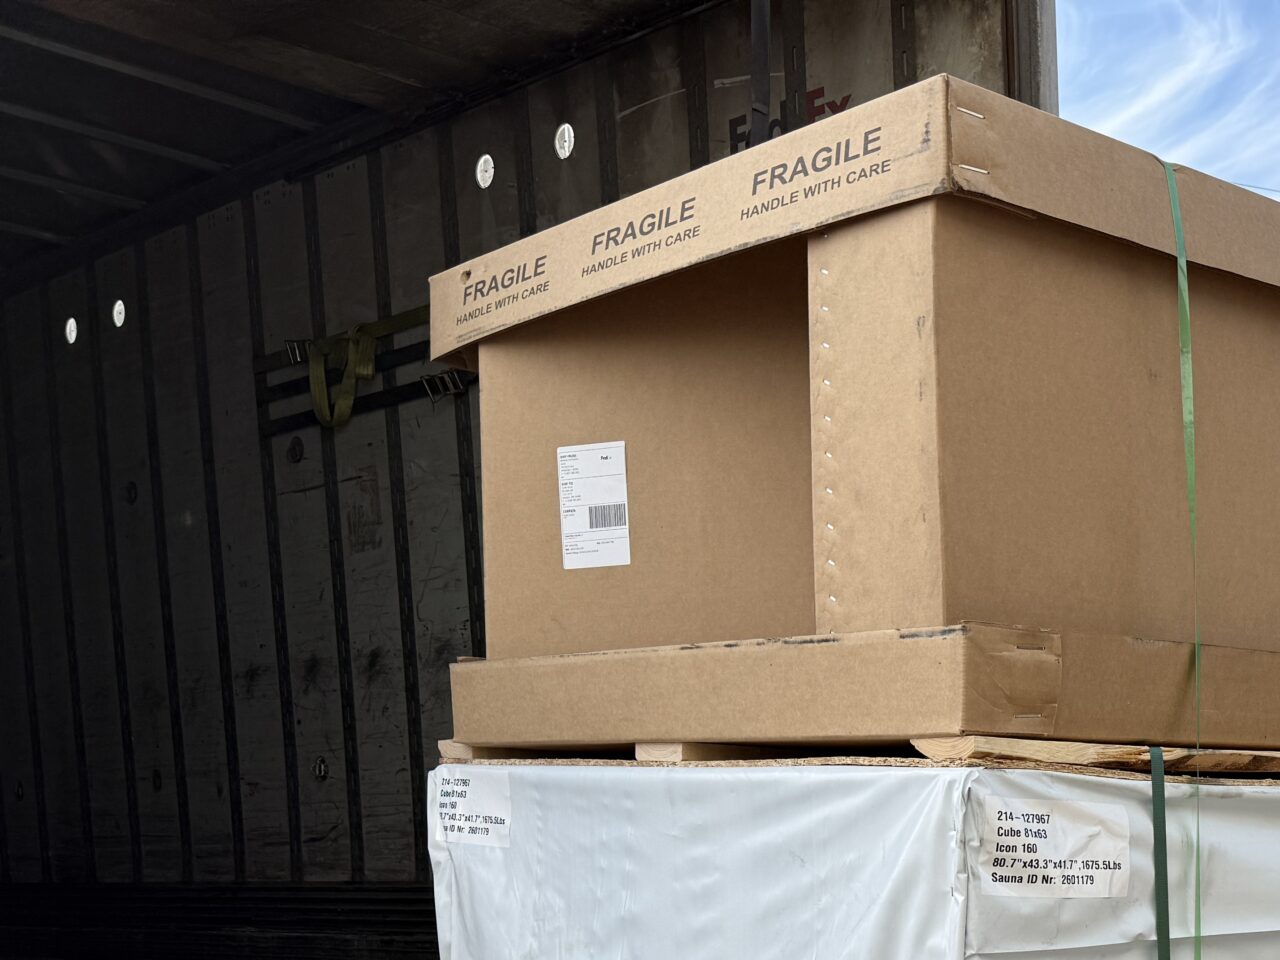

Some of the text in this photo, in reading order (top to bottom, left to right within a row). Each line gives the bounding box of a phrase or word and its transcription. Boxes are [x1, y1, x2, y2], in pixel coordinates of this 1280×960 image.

[752, 126, 882, 196] FRAGILE
[740, 159, 892, 221] HANDLE WITH CARE
[591, 196, 696, 256] FRAGILE
[581, 225, 701, 278] HANDLE WITH CARE
[456, 280, 550, 326] HANDLE WITH CARE
[463, 255, 547, 306] FRAGILE
[996, 810, 1051, 825] 214-127967
[997, 826, 1048, 840] Cube 81x63
[995, 842, 1038, 854] Icon 160
[991, 872, 1095, 886] Sauna ID Nr: 2601179
